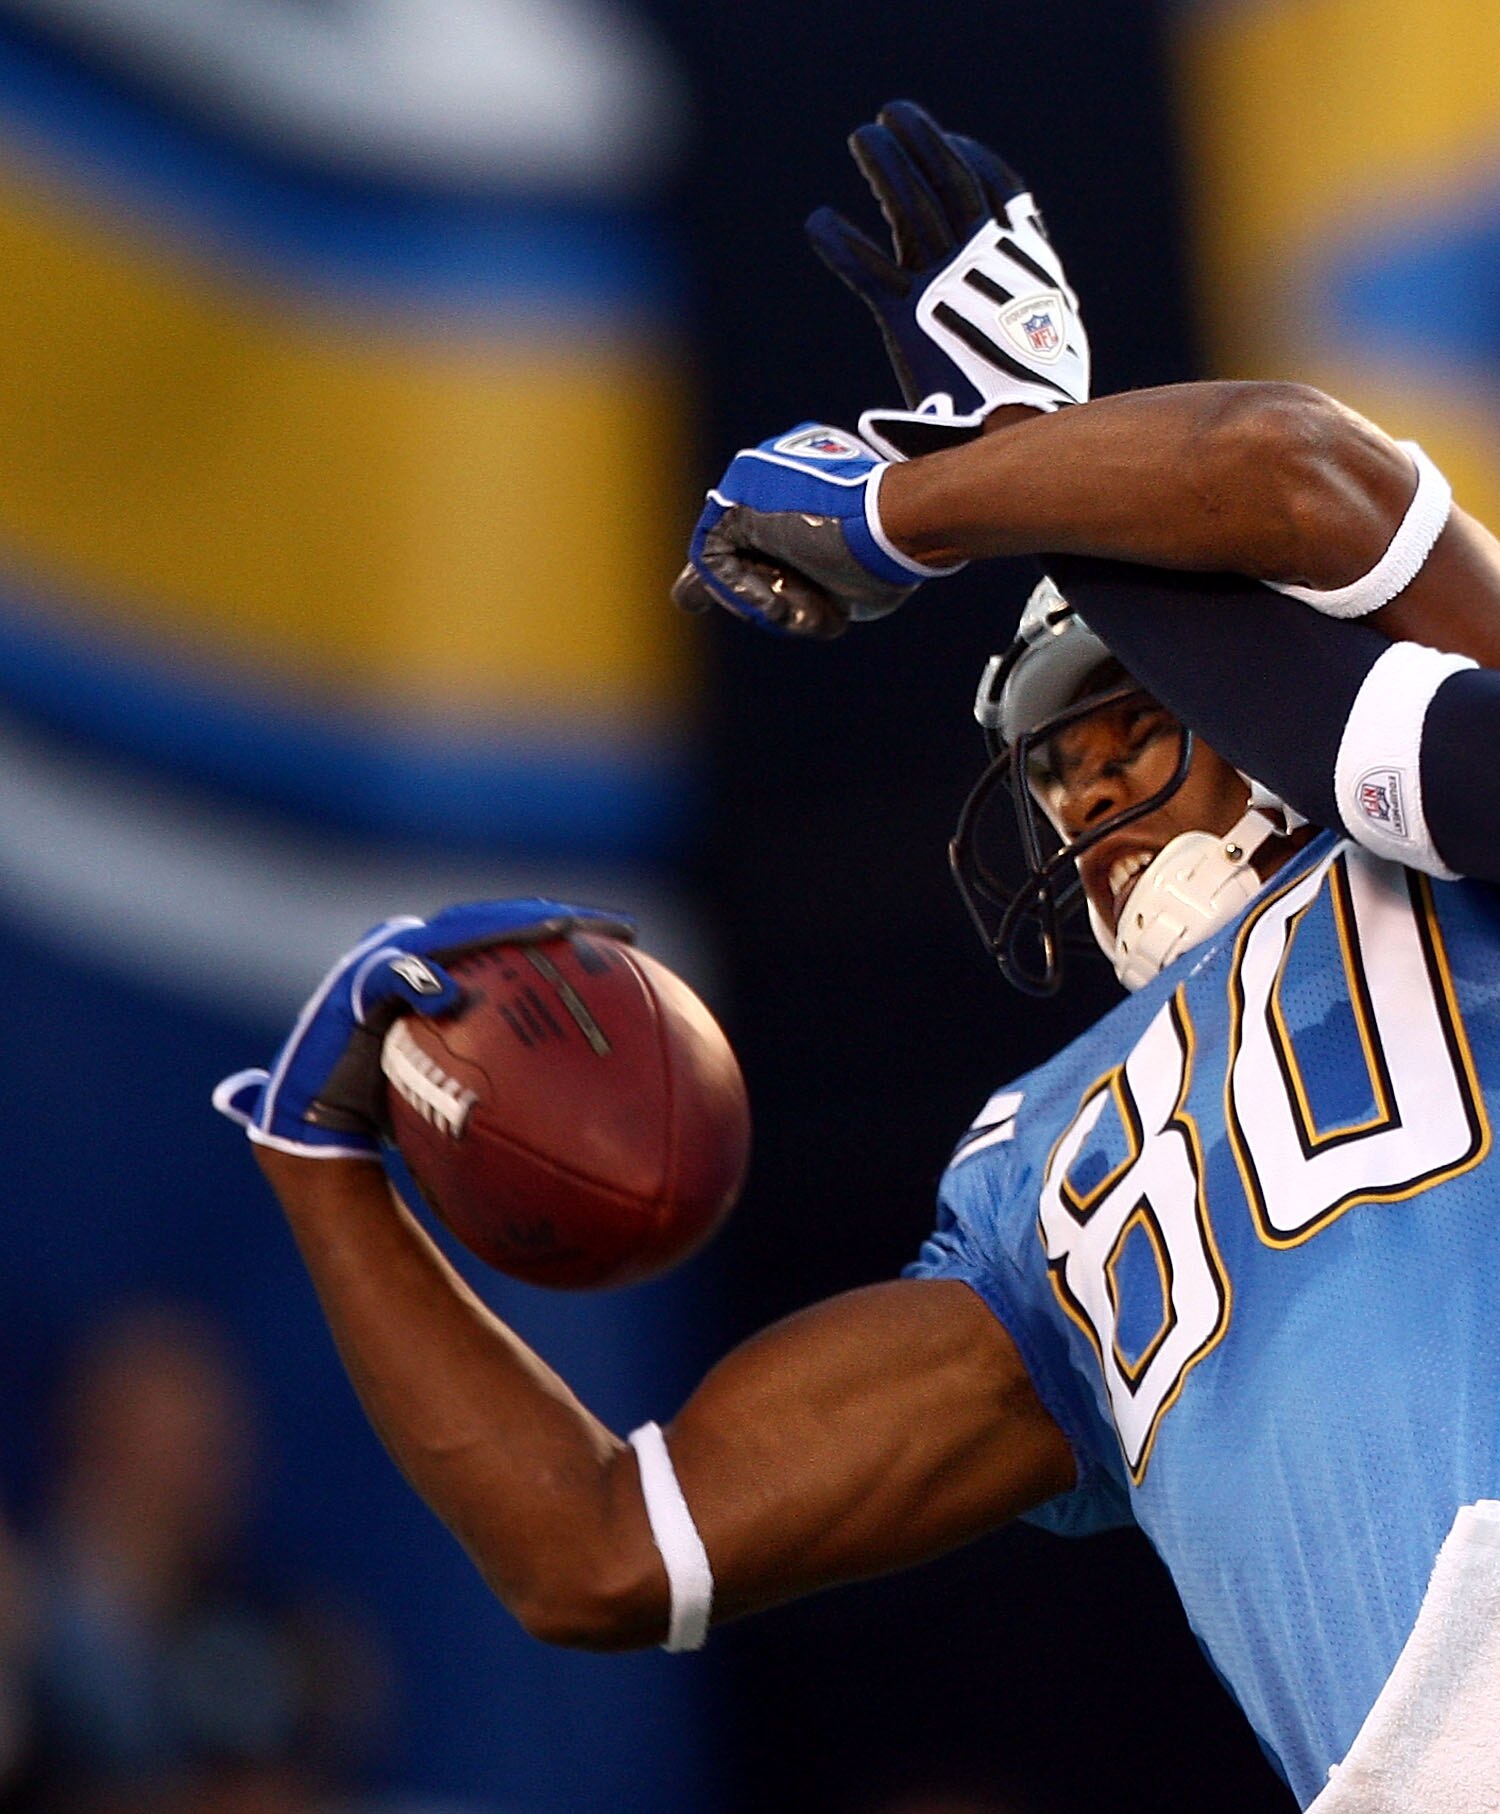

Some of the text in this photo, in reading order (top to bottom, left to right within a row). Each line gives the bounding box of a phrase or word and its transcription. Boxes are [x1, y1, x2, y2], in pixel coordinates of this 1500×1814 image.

[1030, 327, 1059, 350] NFL
[1362, 786, 1379, 818] NFL
[1036, 843, 1493, 1486] 80
